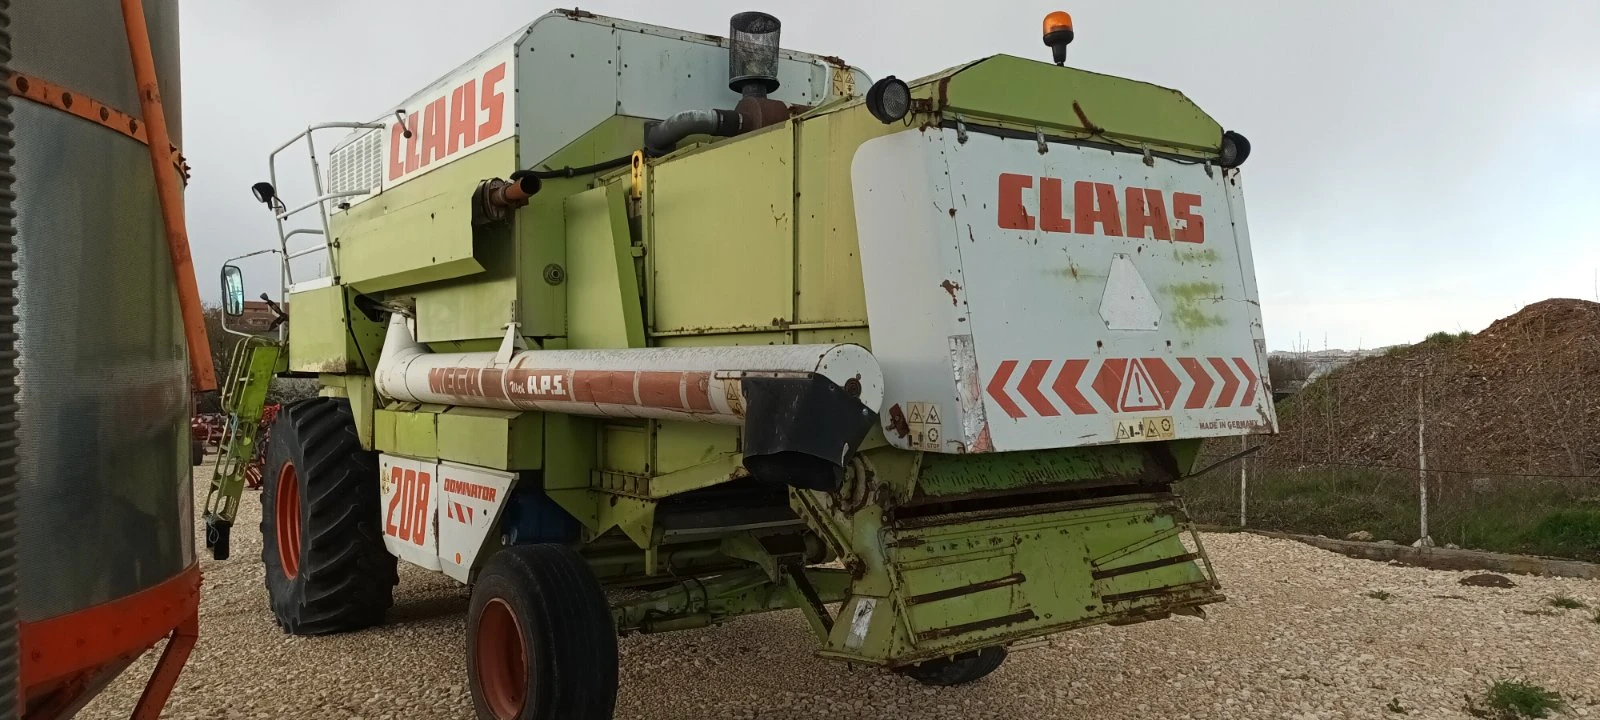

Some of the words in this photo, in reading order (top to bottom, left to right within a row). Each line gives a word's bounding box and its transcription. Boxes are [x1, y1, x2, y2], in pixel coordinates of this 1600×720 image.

[389, 62, 506, 181] CLAAS
[997, 172, 1205, 244] CLAAS
[429, 367, 483, 397] MEGA
[1199, 422, 1218, 430] MADE
[1220, 421, 1227, 429] IN
[1227, 419, 1258, 430] GERMANY
[386, 466, 431, 546] 208
[443, 478, 497, 503] DOMINATOR
